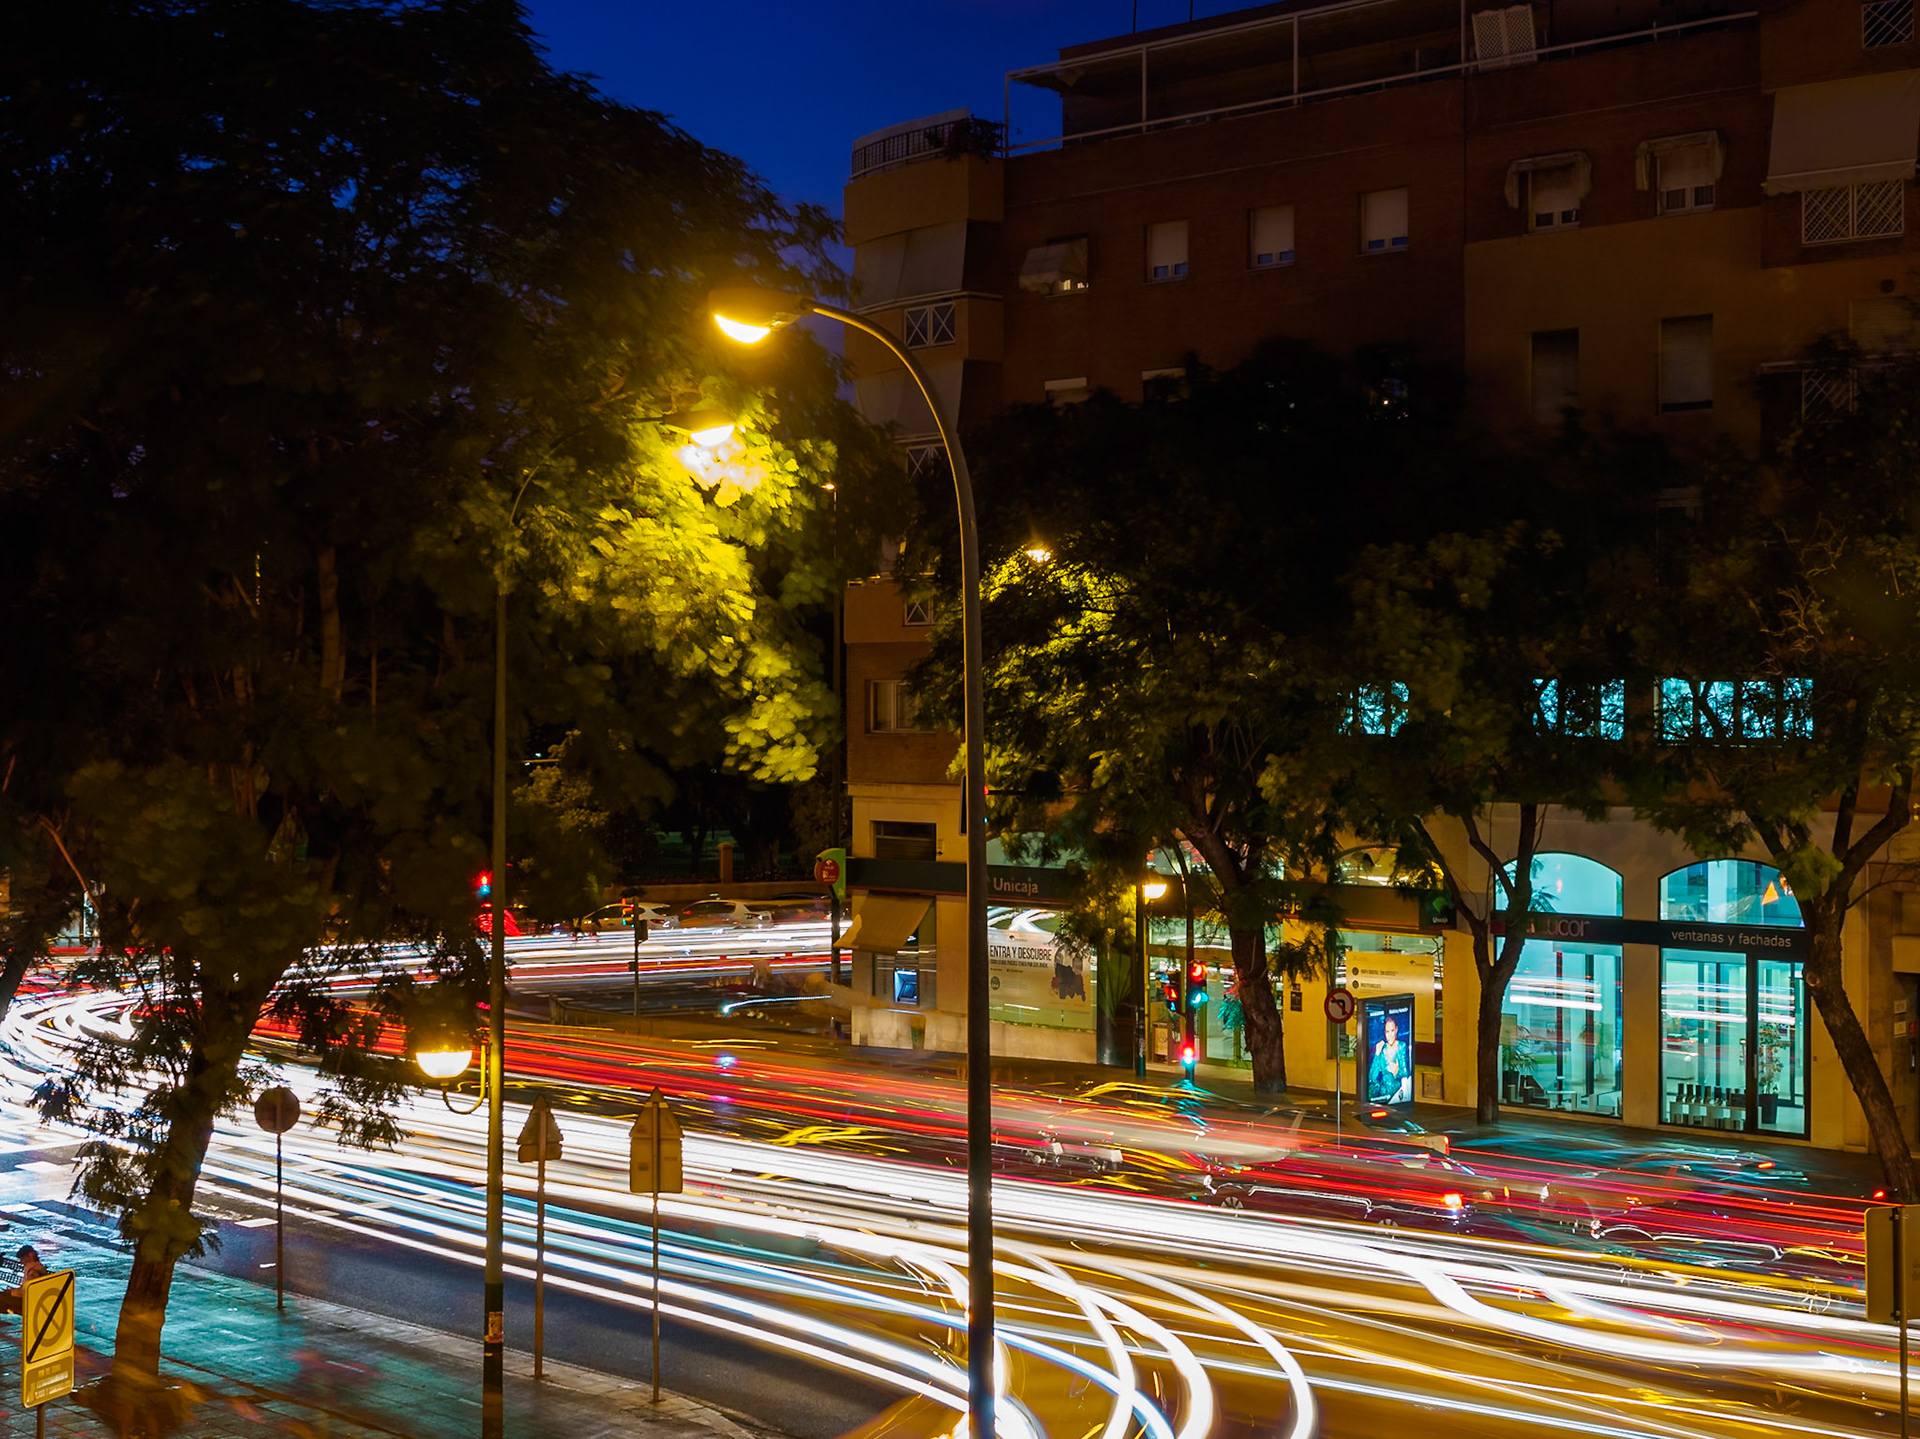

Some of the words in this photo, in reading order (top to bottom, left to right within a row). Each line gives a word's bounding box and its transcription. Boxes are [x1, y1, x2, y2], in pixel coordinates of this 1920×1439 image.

[993, 877, 1039, 896] Unicaja
[1671, 930, 1724, 943] ventanas
[1728, 934, 1735, 946] y
[1739, 932, 1792, 948] fachadas
[990, 945, 1011, 958] ENTRA
[1012, 946, 1017, 958] Y
[1018, 947, 1052, 961] DESCUBRE
